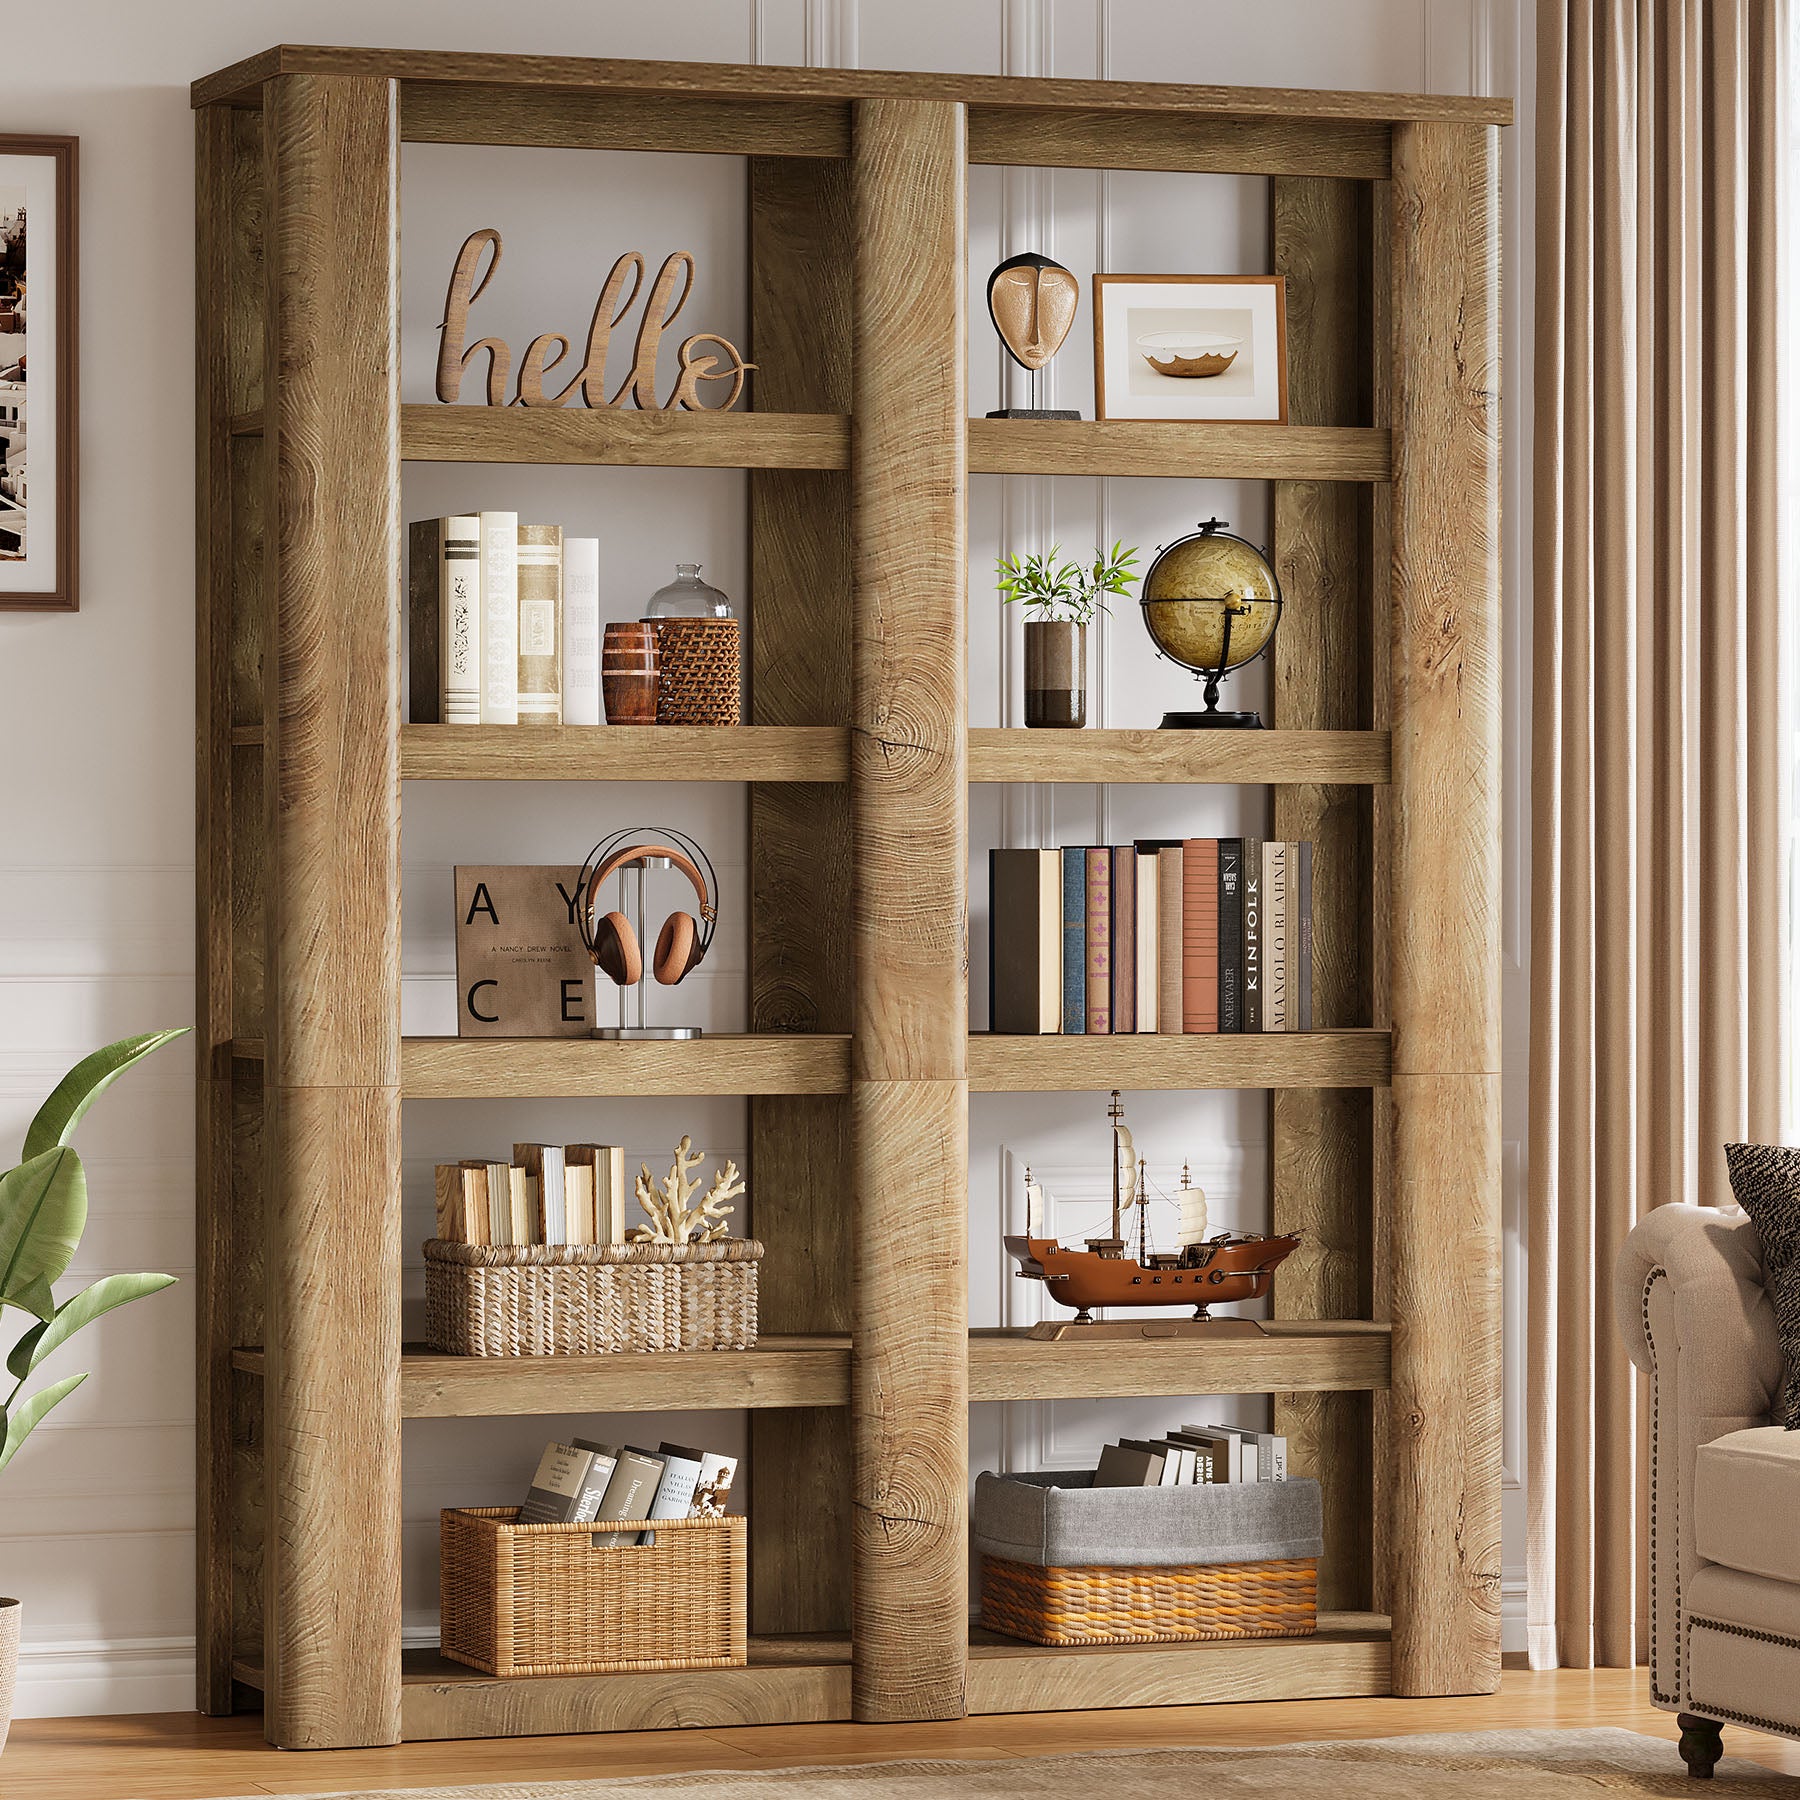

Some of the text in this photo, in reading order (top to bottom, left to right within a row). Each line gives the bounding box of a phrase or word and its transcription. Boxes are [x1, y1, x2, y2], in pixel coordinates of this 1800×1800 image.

[436, 228, 760, 412] hello
[465, 883, 586, 925] A Y
[1247, 879, 1257, 990] KINFOLK
[1272, 849, 1285, 1025] MANOLO BLAHNÍK
[467, 979, 585, 1022] C E
[618, 1479, 643, 1518] Dreaming
